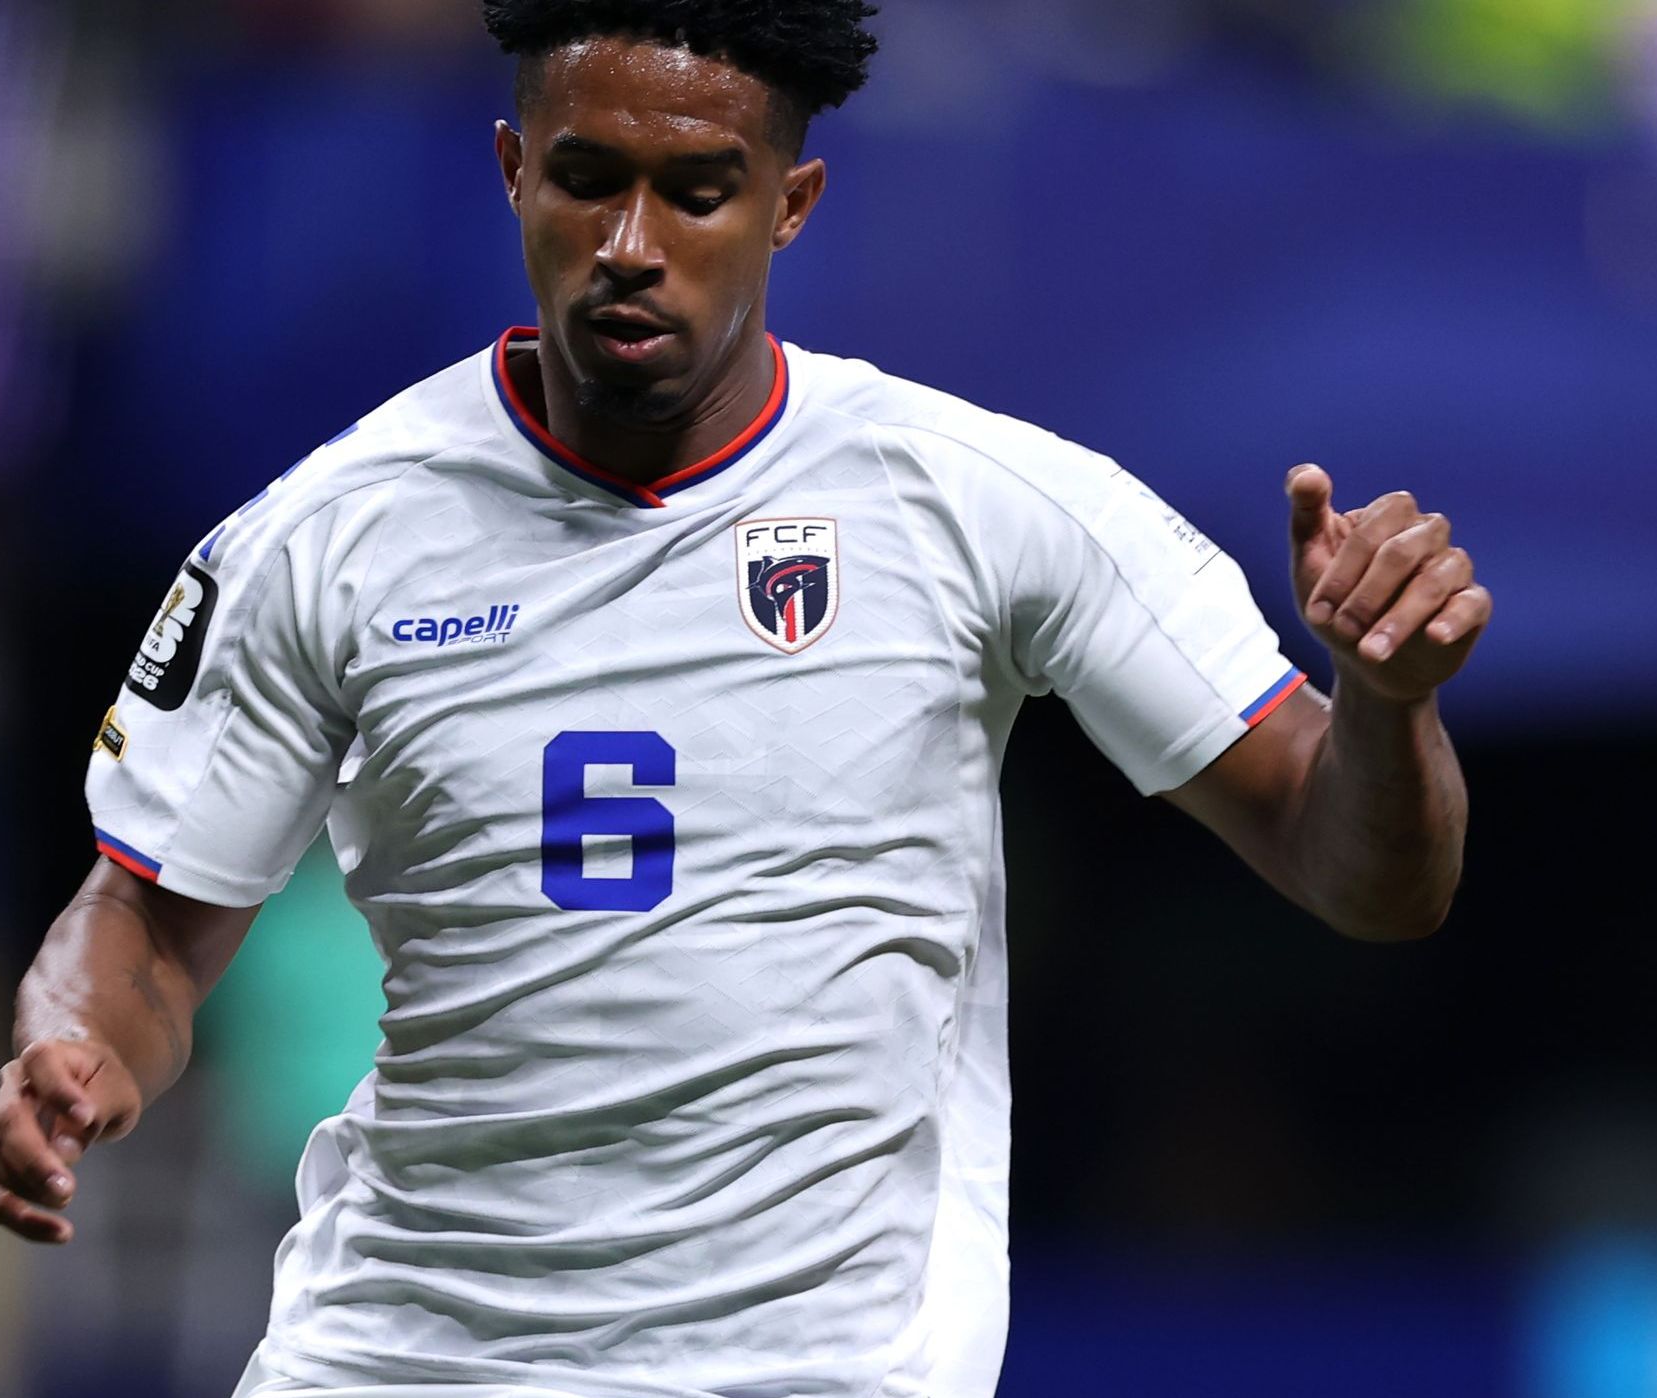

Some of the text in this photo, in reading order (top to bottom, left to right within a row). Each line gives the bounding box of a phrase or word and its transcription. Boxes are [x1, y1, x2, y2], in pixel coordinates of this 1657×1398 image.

[746, 525, 827, 547] FCF
[392, 604, 520, 647] capelli
[542, 730, 676, 912] 6
